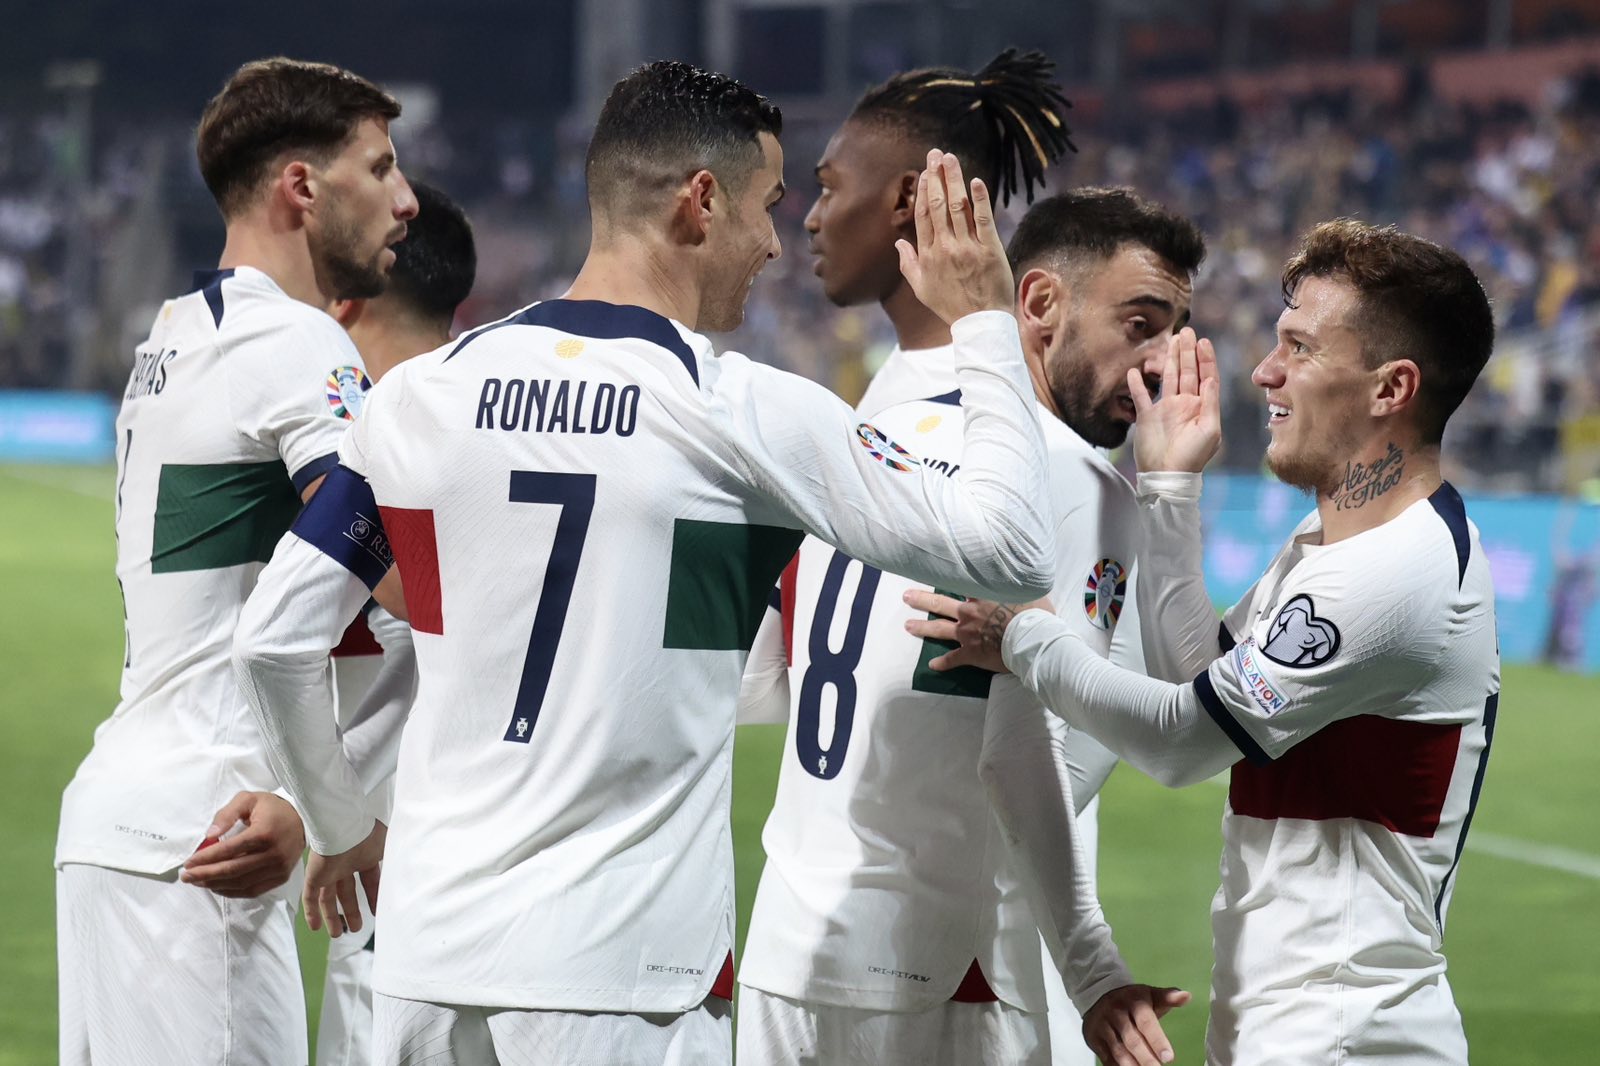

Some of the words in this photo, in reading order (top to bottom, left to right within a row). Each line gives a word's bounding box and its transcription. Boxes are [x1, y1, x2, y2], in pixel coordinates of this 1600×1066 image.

[475, 378, 641, 437] RONALDO
[503, 470, 597, 744] 7
[796, 549, 882, 780] 8
